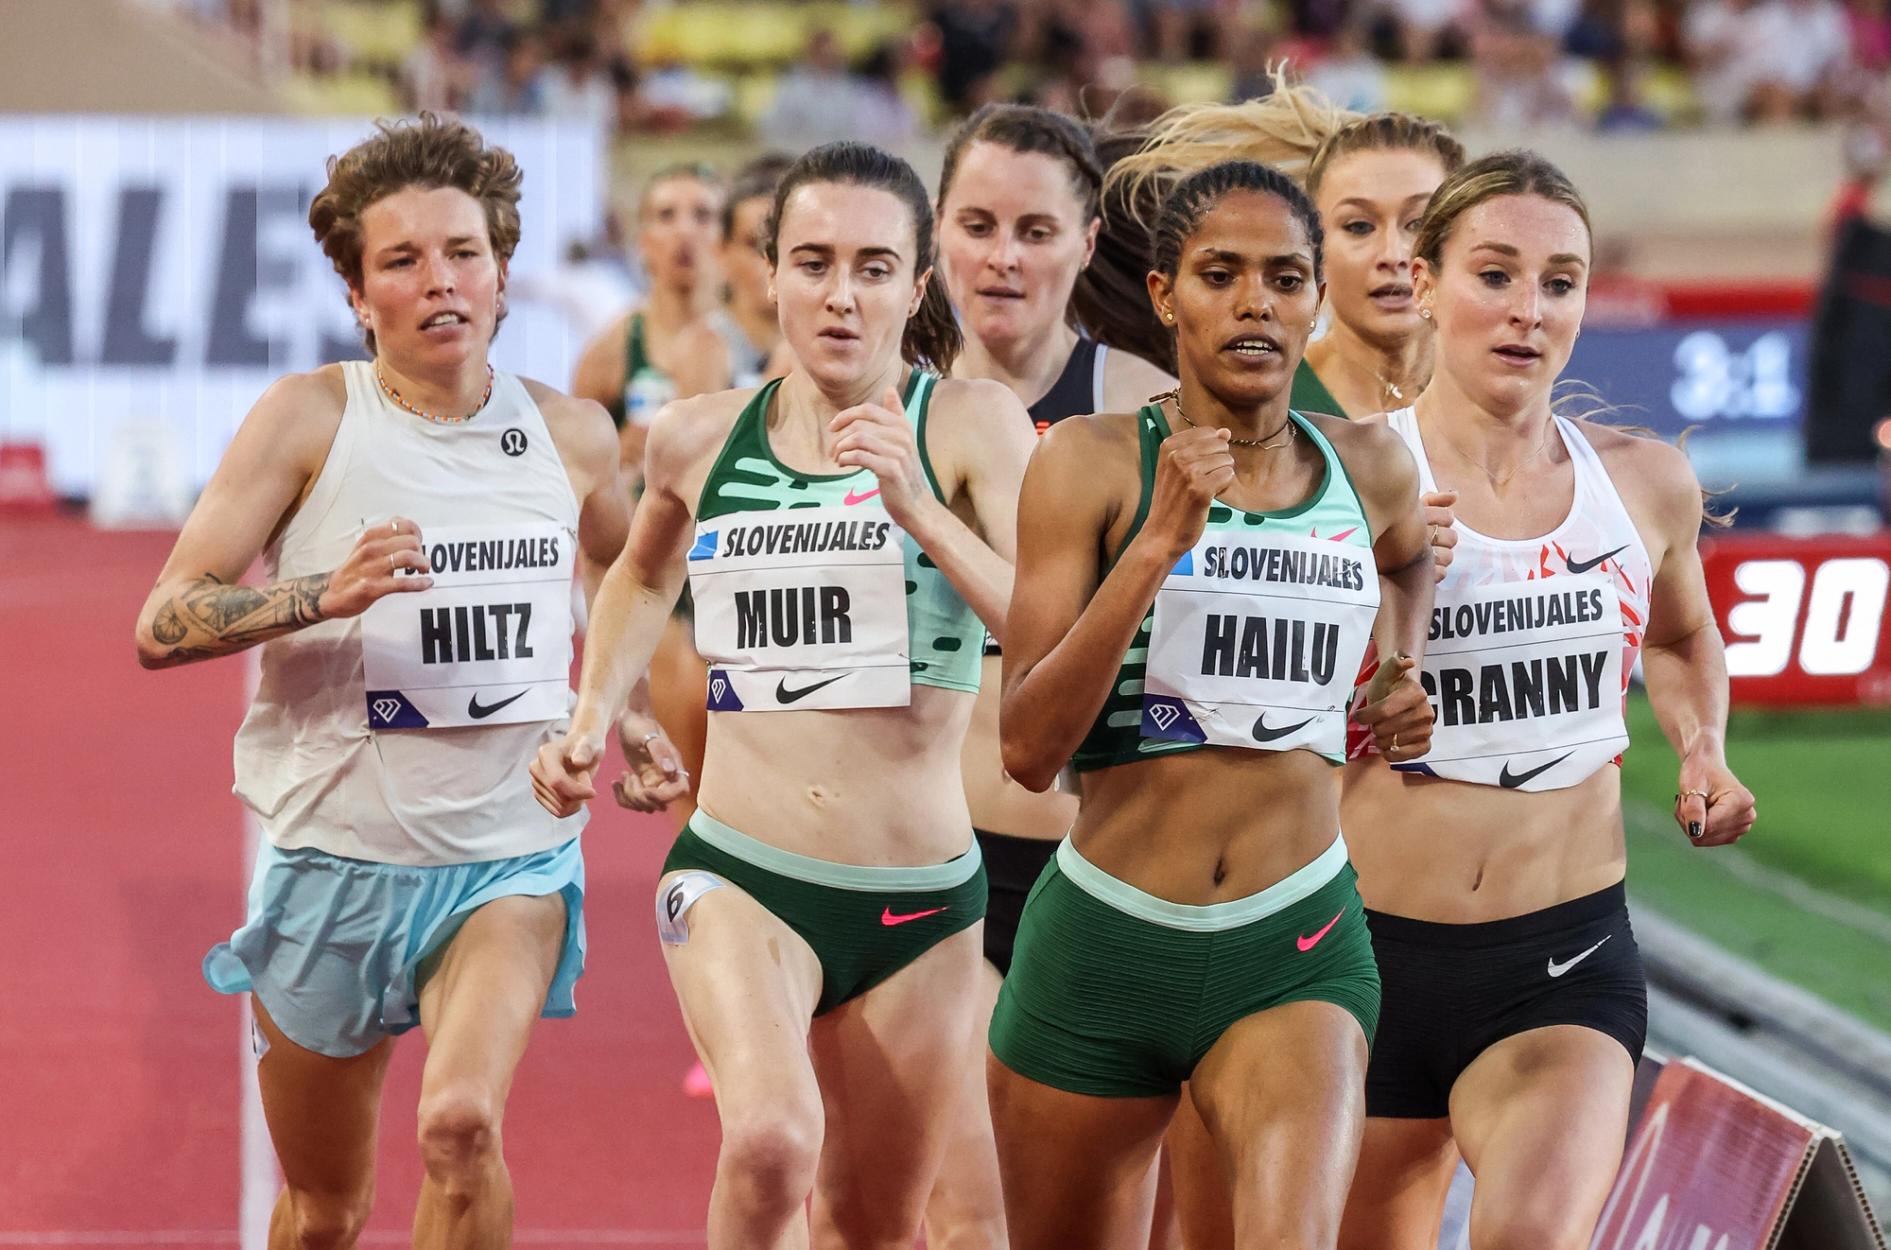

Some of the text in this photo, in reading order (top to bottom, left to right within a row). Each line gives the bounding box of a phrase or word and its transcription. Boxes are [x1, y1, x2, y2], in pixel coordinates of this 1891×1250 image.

[0, 187, 376, 366] ALE
[404, 537, 559, 575] OVENIJALES
[723, 521, 889, 557] SLOVENIJALES
[1204, 546, 1364, 591] SLOVENIJALES
[420, 602, 533, 664] HILTZ
[734, 586, 852, 649] MUIR
[1427, 589, 1604, 641] SLOVENIJALES
[1724, 558, 1889, 676] 30
[1201, 614, 1340, 686] HAILU
[667, 881, 684, 922] 6
